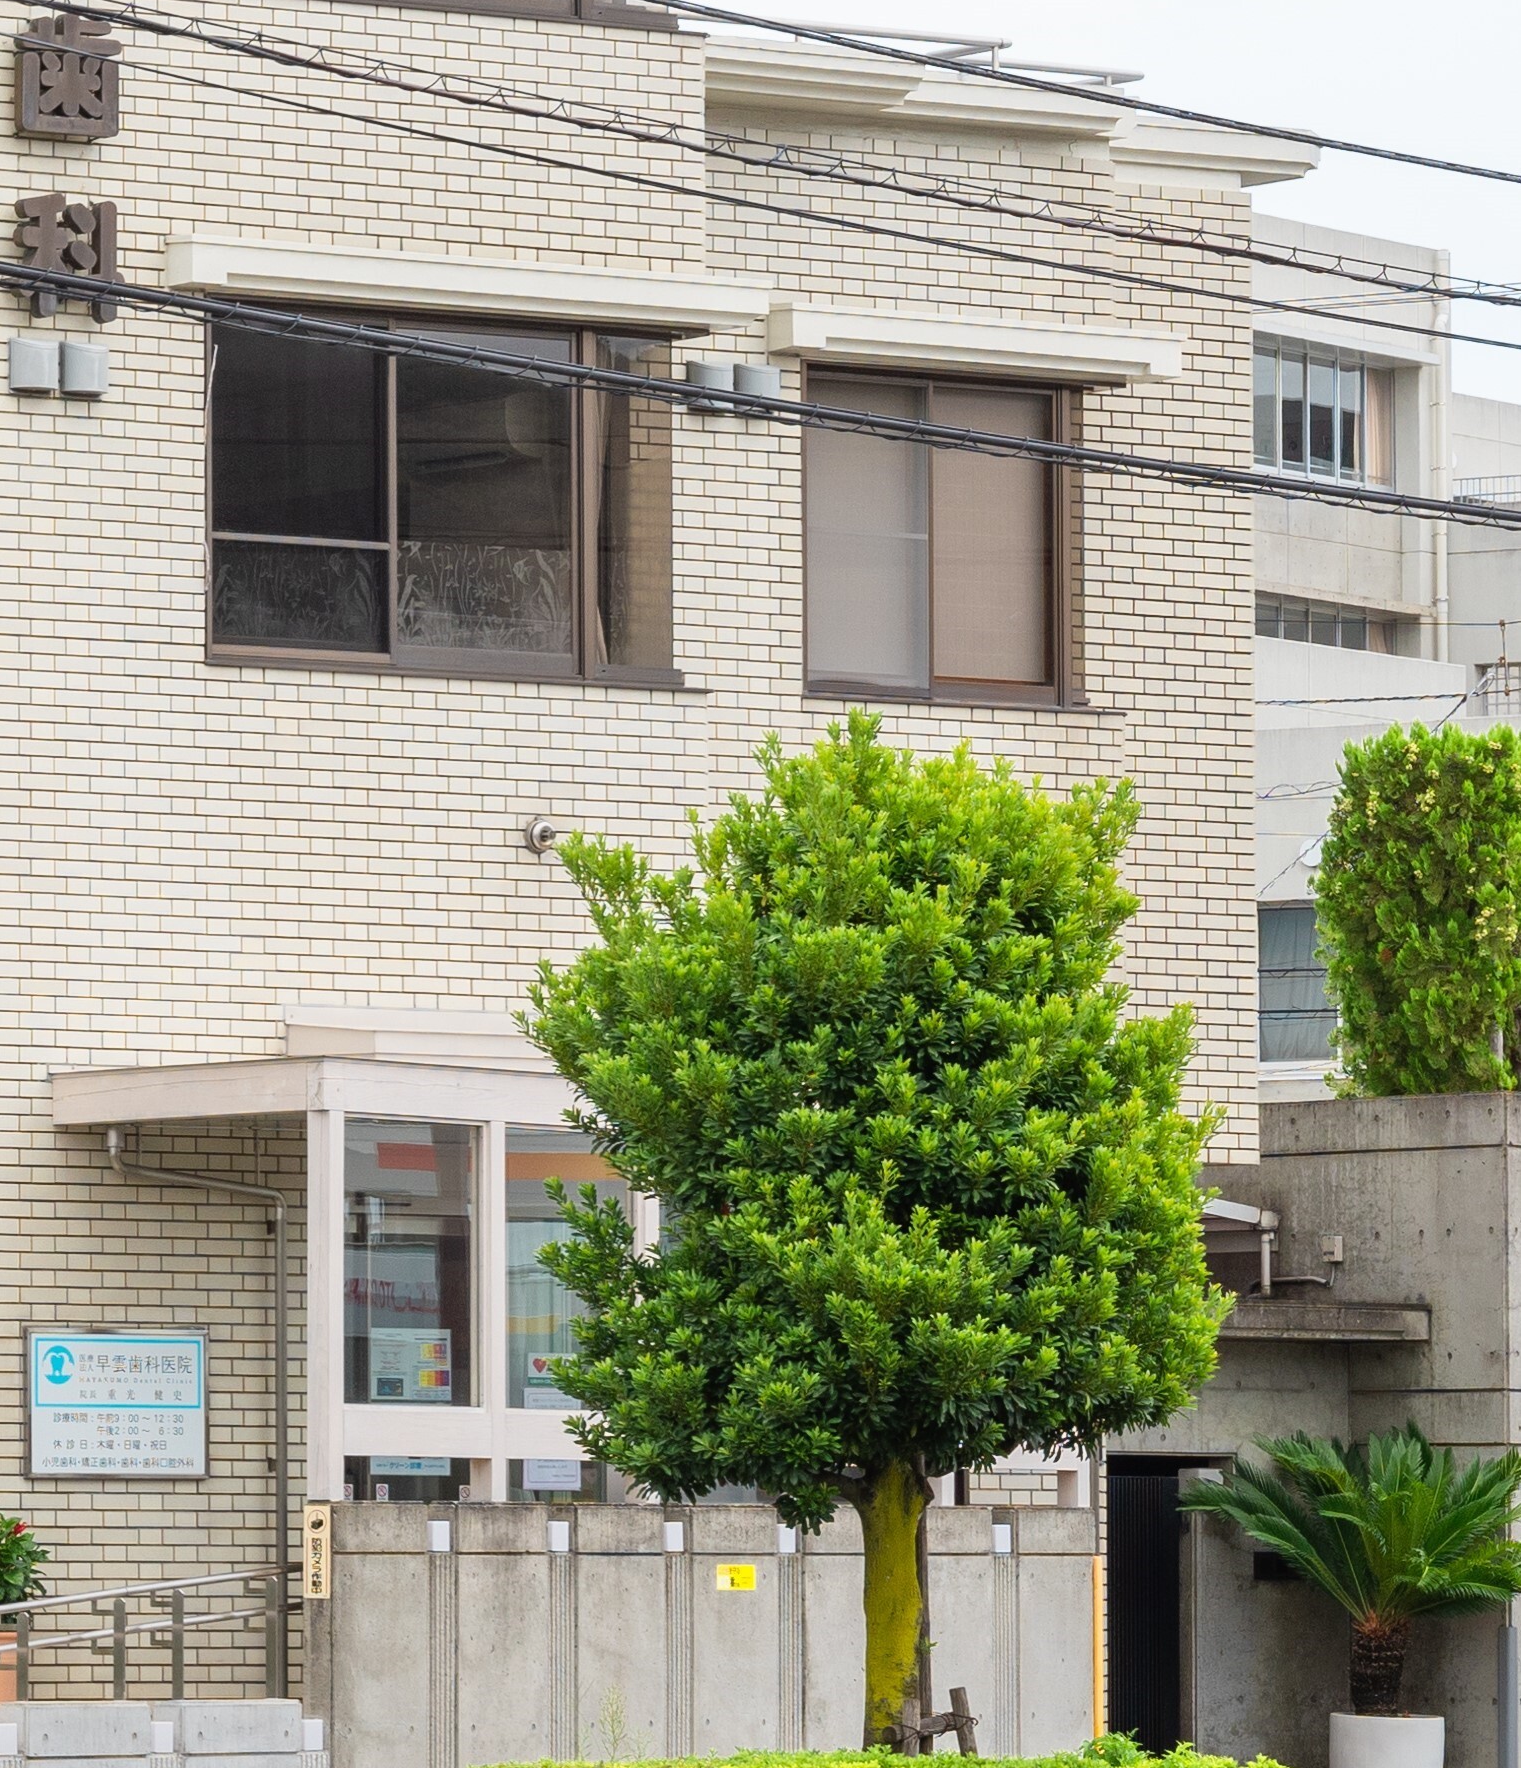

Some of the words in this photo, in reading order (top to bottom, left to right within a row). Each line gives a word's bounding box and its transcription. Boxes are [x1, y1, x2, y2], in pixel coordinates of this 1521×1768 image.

[79, 1354, 94, 1363] 医療
[79, 1364, 94, 1372] 法人
[96, 1354, 193, 1374] 早雲歯科医院
[79, 1376, 129, 1384] HAYAKUMO
[166, 1377, 193, 1385] Clinic
[311, 1537, 323, 1594] 防犯カメラ作動中
